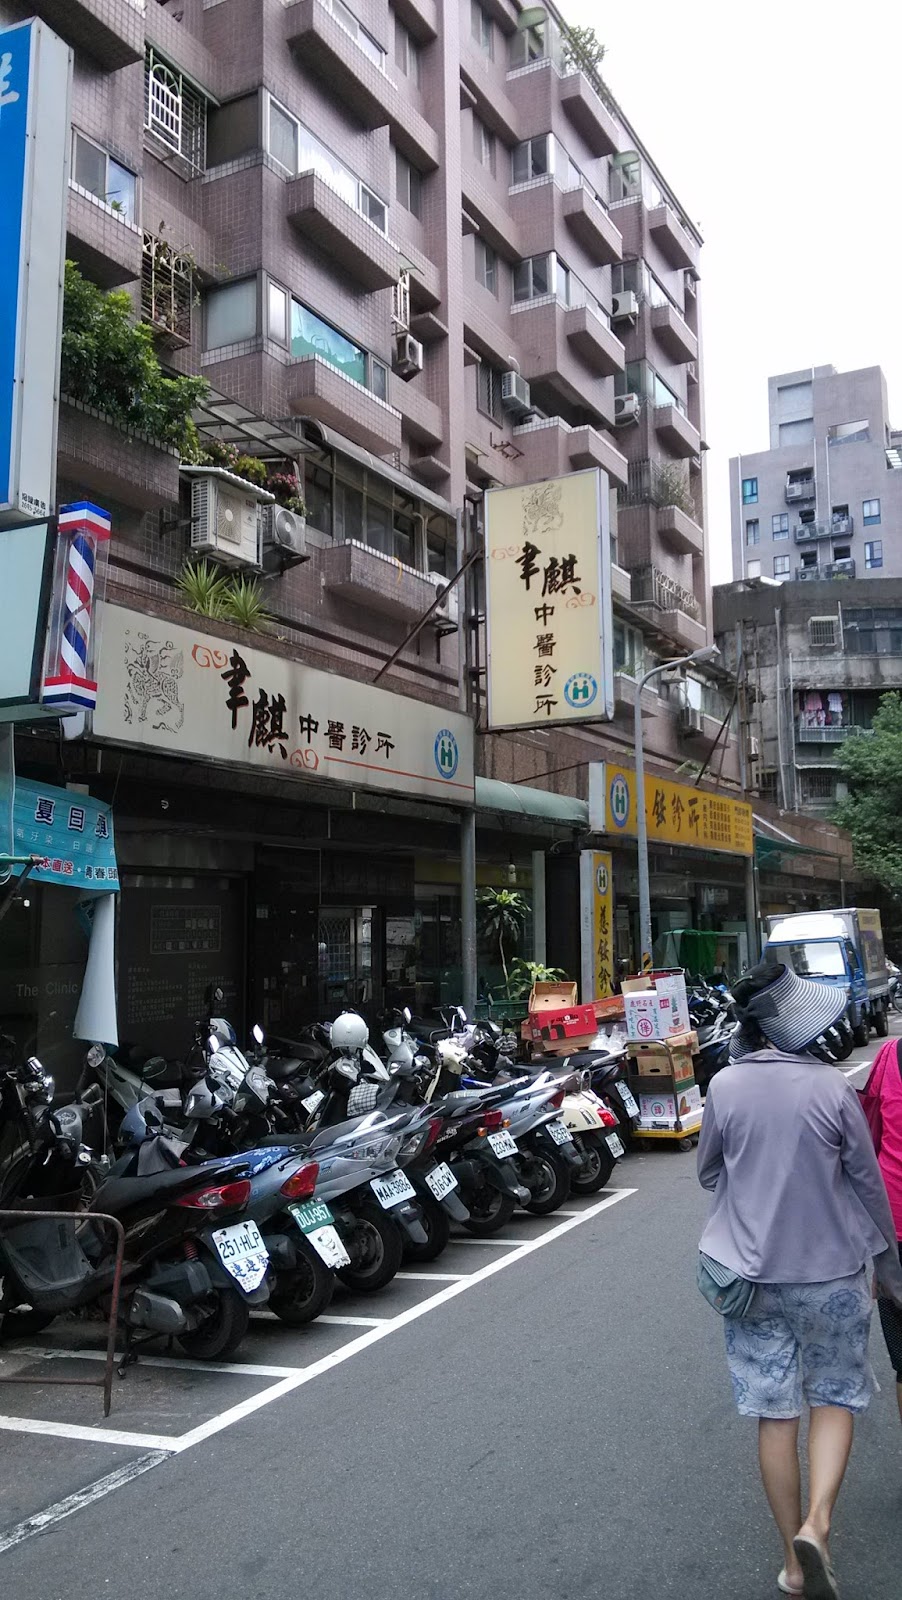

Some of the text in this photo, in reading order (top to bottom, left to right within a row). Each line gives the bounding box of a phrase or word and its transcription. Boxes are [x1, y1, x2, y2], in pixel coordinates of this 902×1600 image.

[533, 602, 558, 716] 中醫診所
[16, 981, 79, 997] The Clinic
[295, 1204, 331, 1229] DUJ-957
[218, 1232, 260, 1259] 251-HLP
